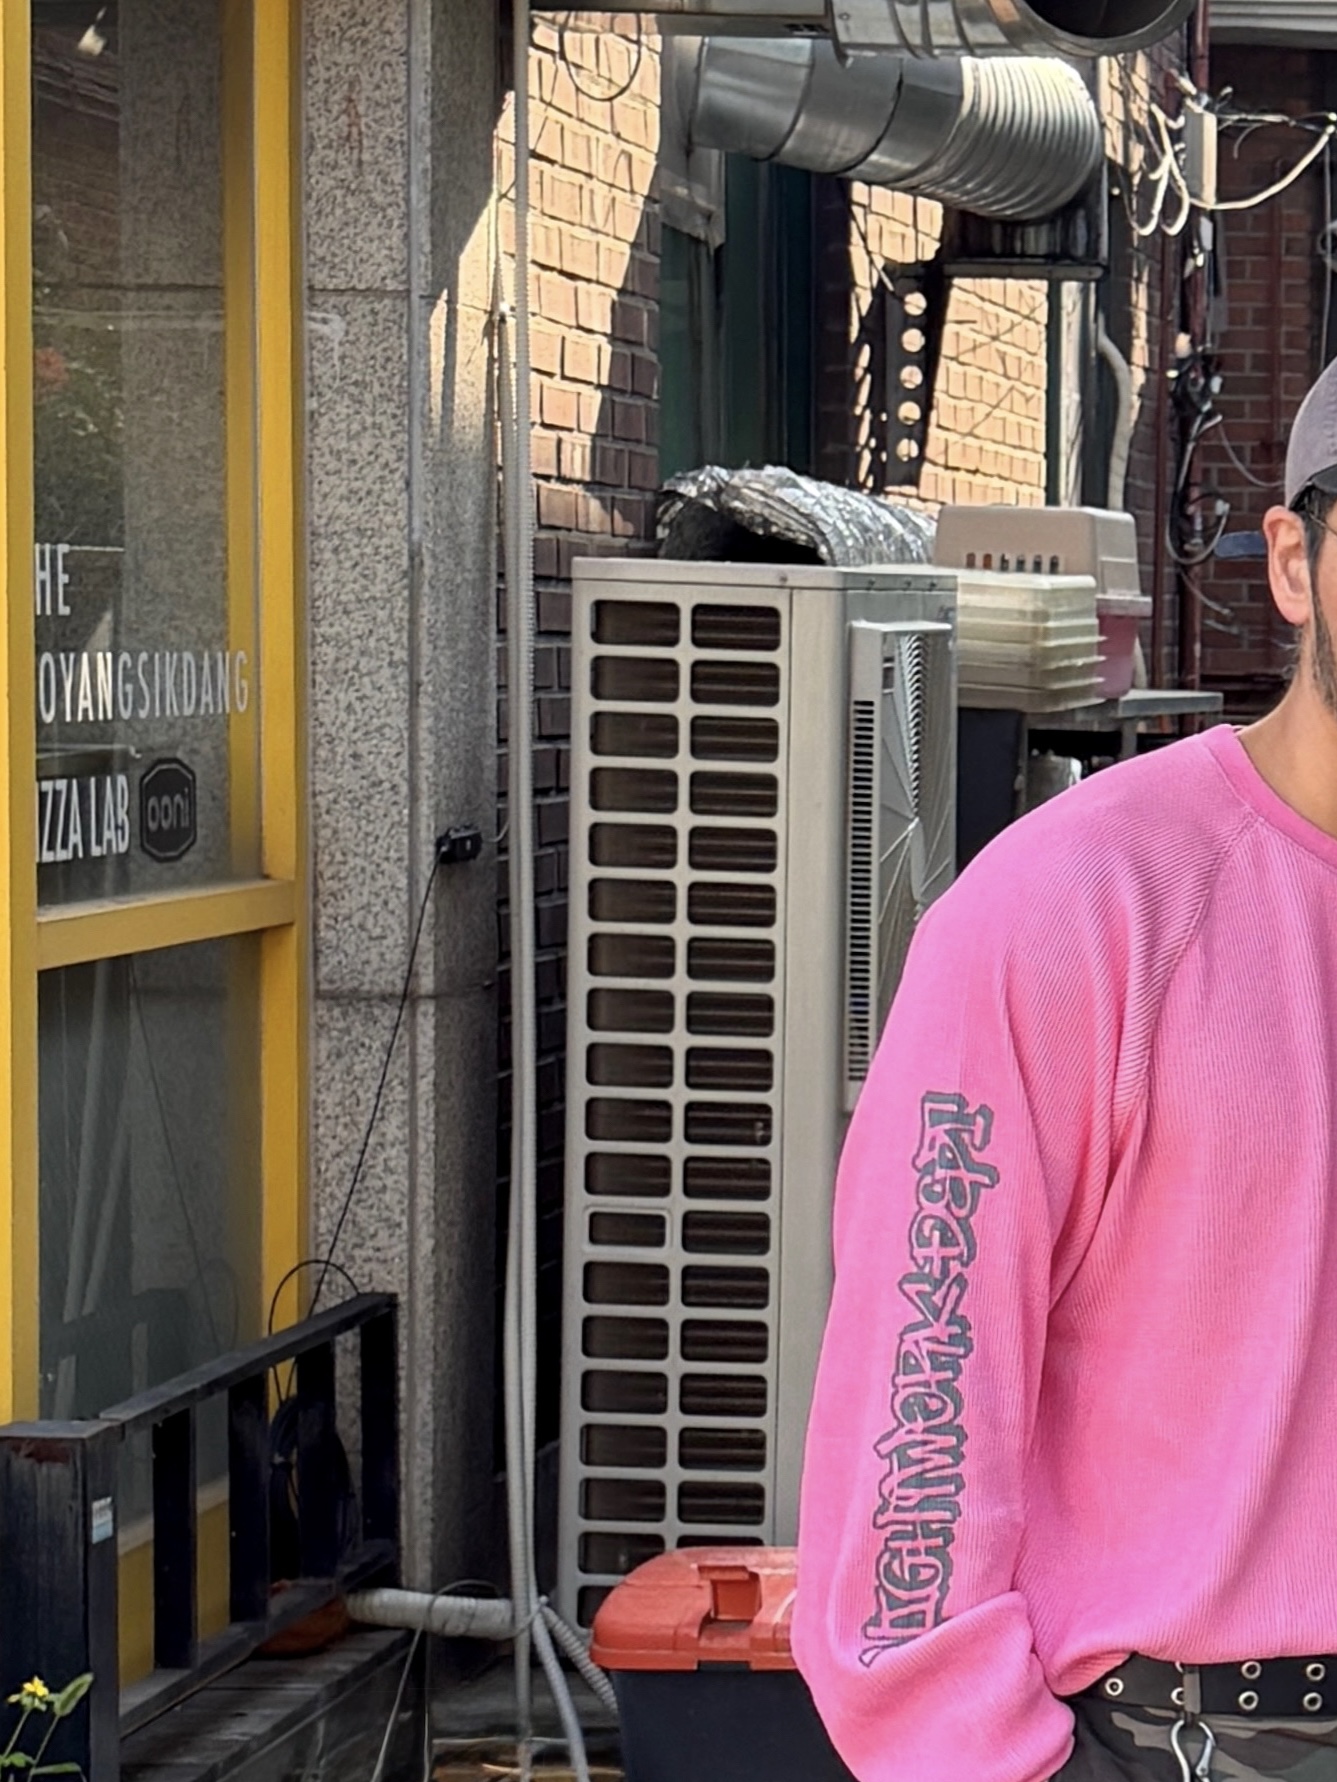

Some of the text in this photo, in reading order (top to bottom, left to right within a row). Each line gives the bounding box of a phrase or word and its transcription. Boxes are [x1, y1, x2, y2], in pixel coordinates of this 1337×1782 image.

[35, 543, 71, 616] HE
[39, 651, 249, 724] OYANGSIKDANG
[90, 774, 129, 857] LAB
